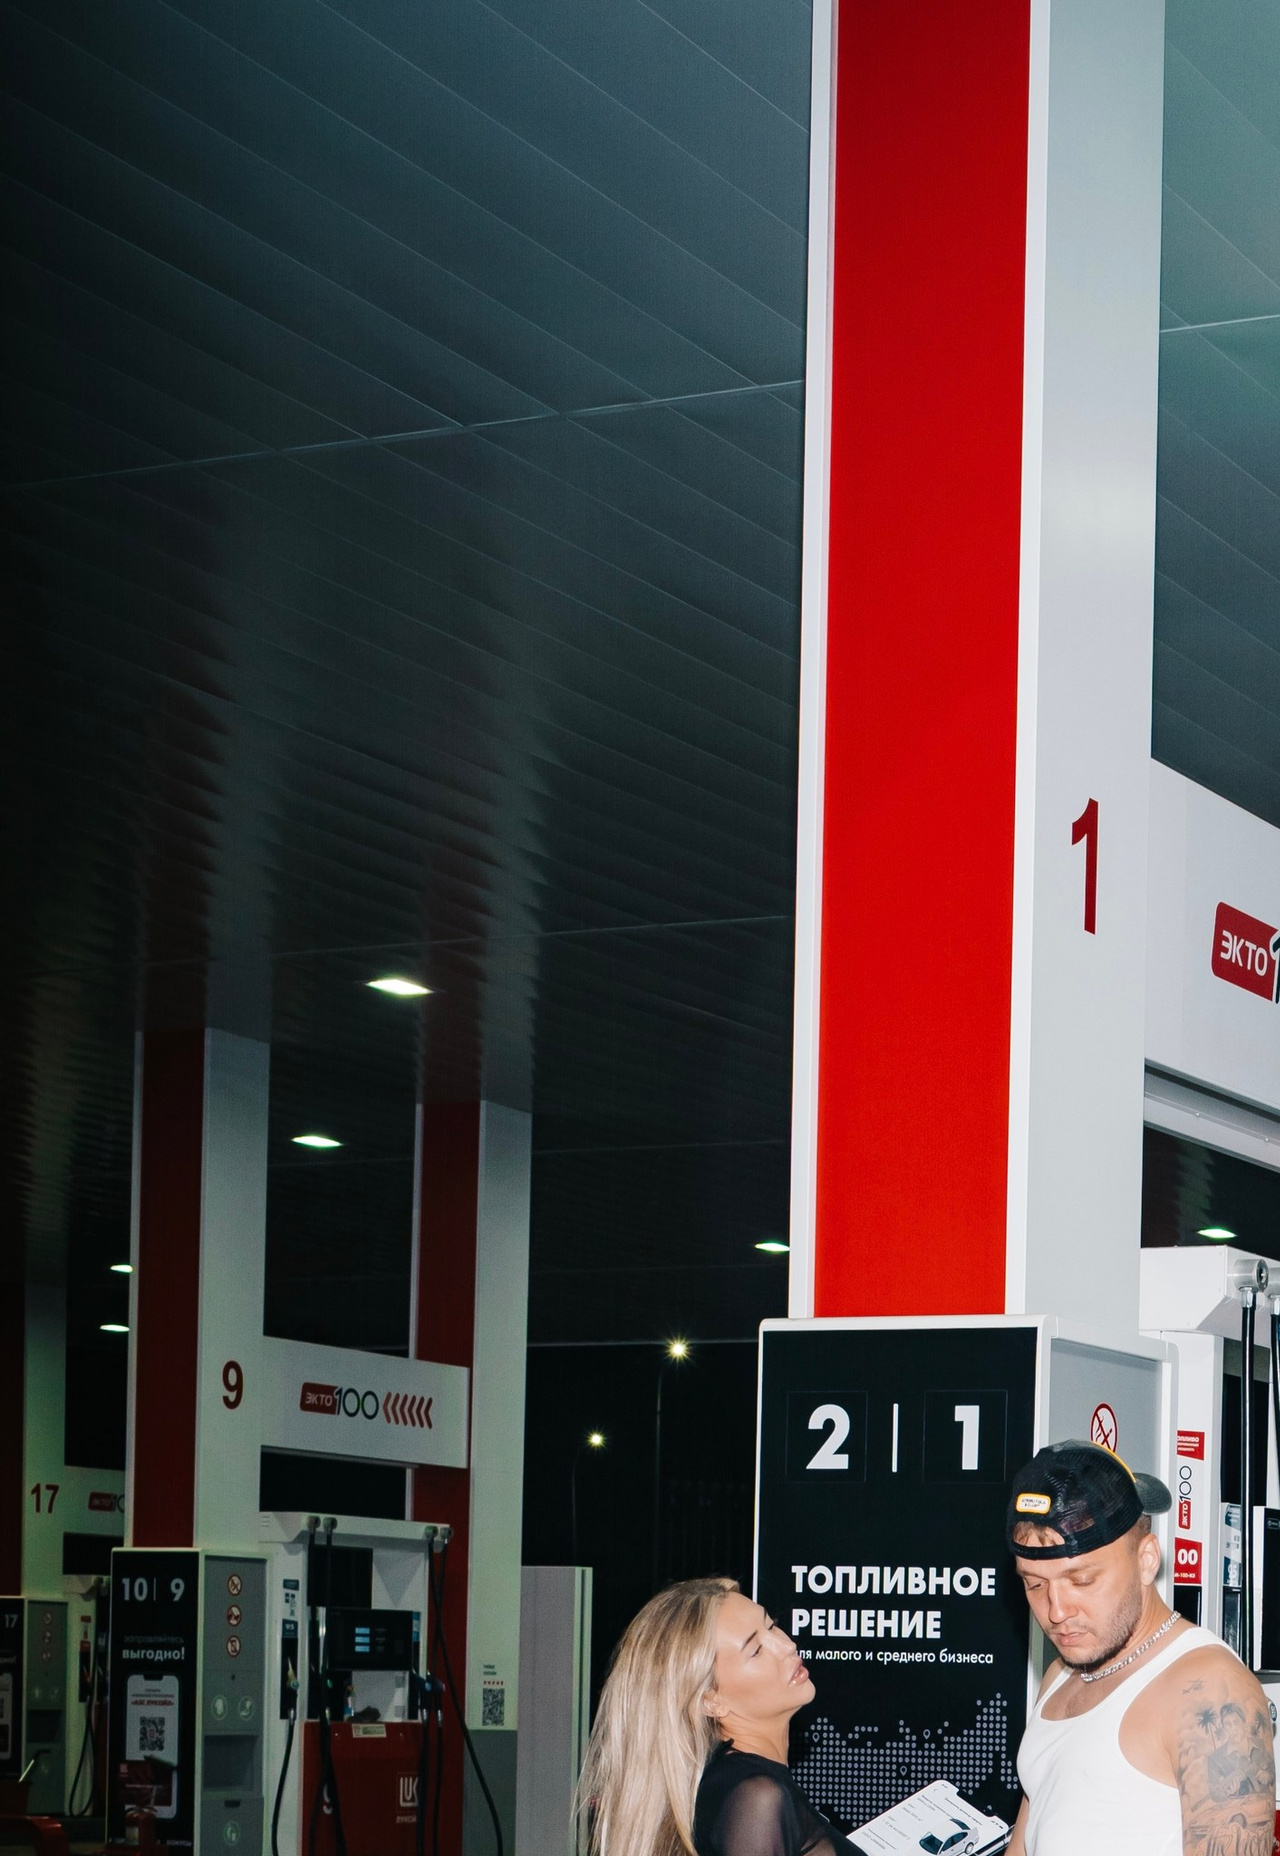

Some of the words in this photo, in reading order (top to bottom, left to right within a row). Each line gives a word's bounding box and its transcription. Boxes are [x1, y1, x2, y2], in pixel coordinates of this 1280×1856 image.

[1072, 797, 1099, 936] 1
[1220, 929, 1268, 977] ЭКТО
[222, 1360, 243, 1410] 9
[806, 1403, 850, 1470] 2
[954, 1405, 980, 1470] 1
[31, 1483, 59, 1514] 17
[122, 1577, 148, 1601] 10
[170, 1577, 185, 1601] 9
[791, 1565, 996, 1596] ТОПЛИВНОЕ
[791, 1608, 942, 1639] РЕШЕНИЕ
[122, 1647, 186, 1662] выгодно!
[796, 1650, 812, 1660] ля
[815, 1650, 862, 1661] малого
[865, 1651, 873, 1661] и
[876, 1651, 936, 1665] среднего
[939, 1648, 994, 1664] бизнеса
